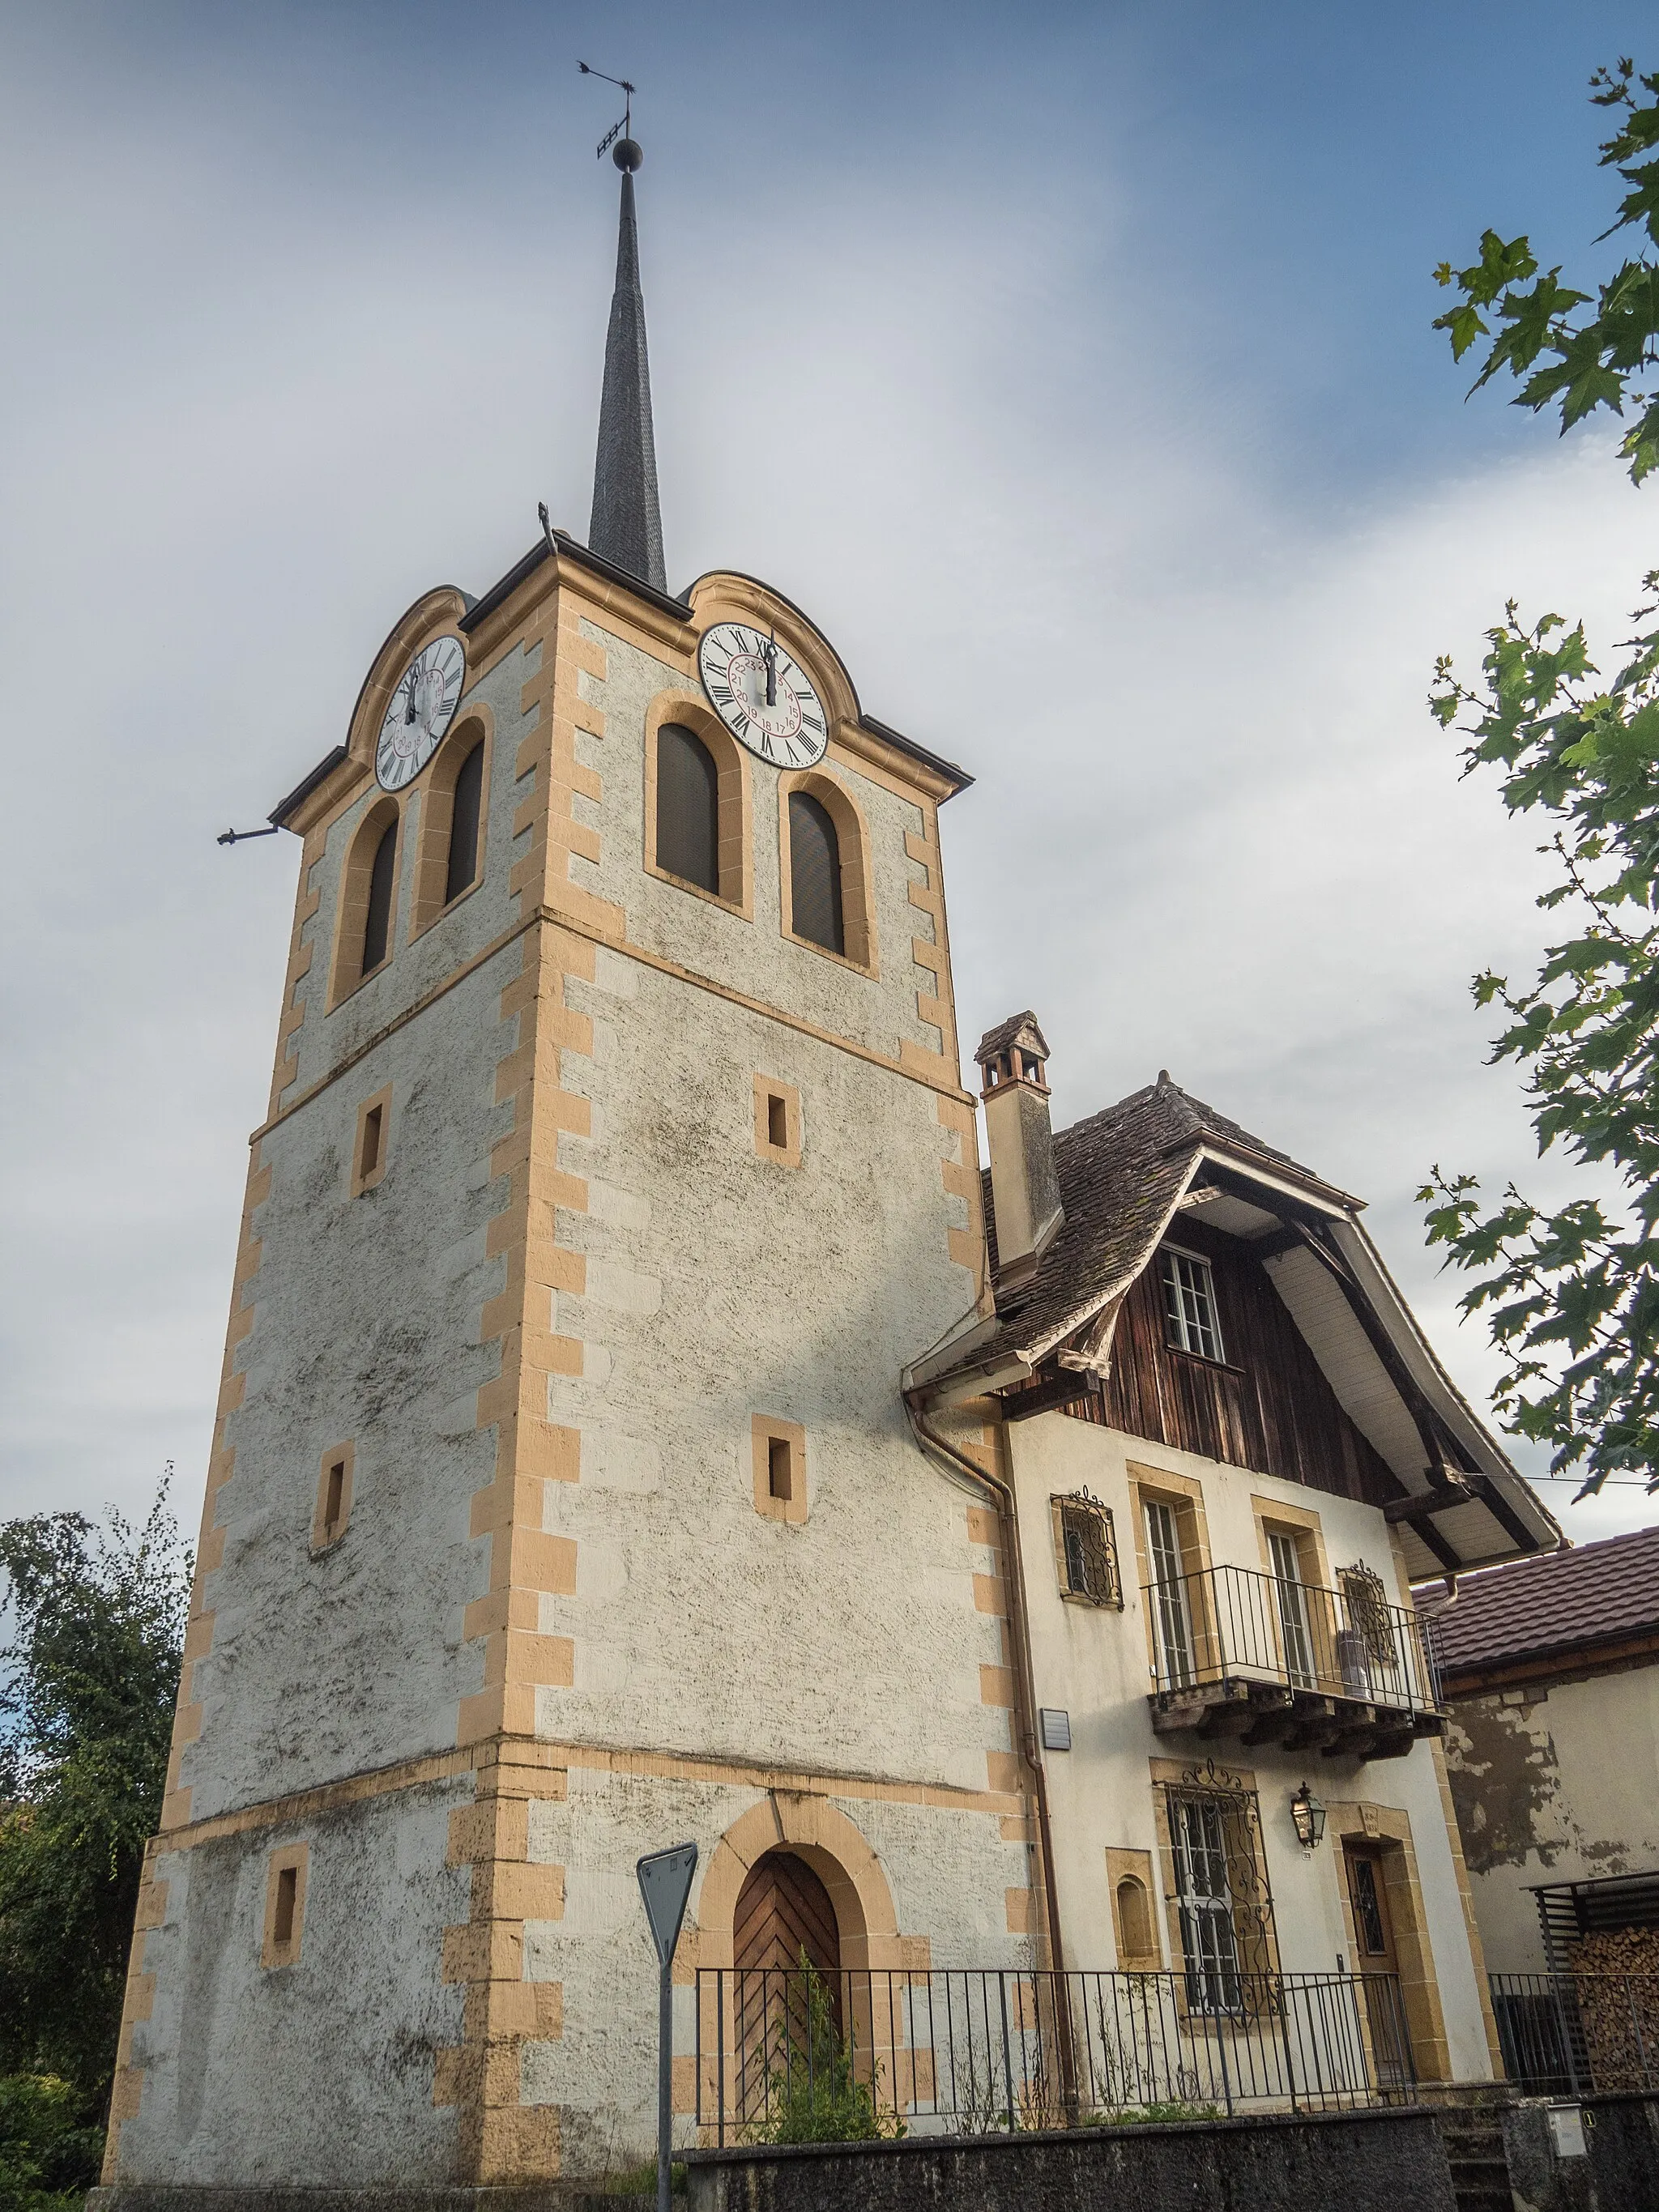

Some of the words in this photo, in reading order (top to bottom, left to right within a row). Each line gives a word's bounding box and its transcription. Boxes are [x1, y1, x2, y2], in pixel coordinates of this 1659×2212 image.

[711, 635, 734, 660] X
[728, 630, 750, 653] XI
[706, 655, 727, 680] IX
[735, 662, 746, 675] 22
[745, 658, 756, 671] 23
[782, 663, 792, 676] I
[731, 673, 741, 686] 21
[710, 685, 735, 707] VIII
[736, 689, 748, 702] 20
[783, 689, 793, 702] 14
[795, 691, 815, 700] II
[747, 705, 757, 718] 19
[789, 705, 799, 718] 15
[731, 712, 750, 738] VII
[762, 718, 772, 731] 18
[775, 722, 786, 734] 17
[785, 717, 795, 730] 16
[802, 711, 822, 733] III
[761, 731, 775, 757] VI
[795, 729, 819, 757] IIII
[785, 739, 800, 762] V
